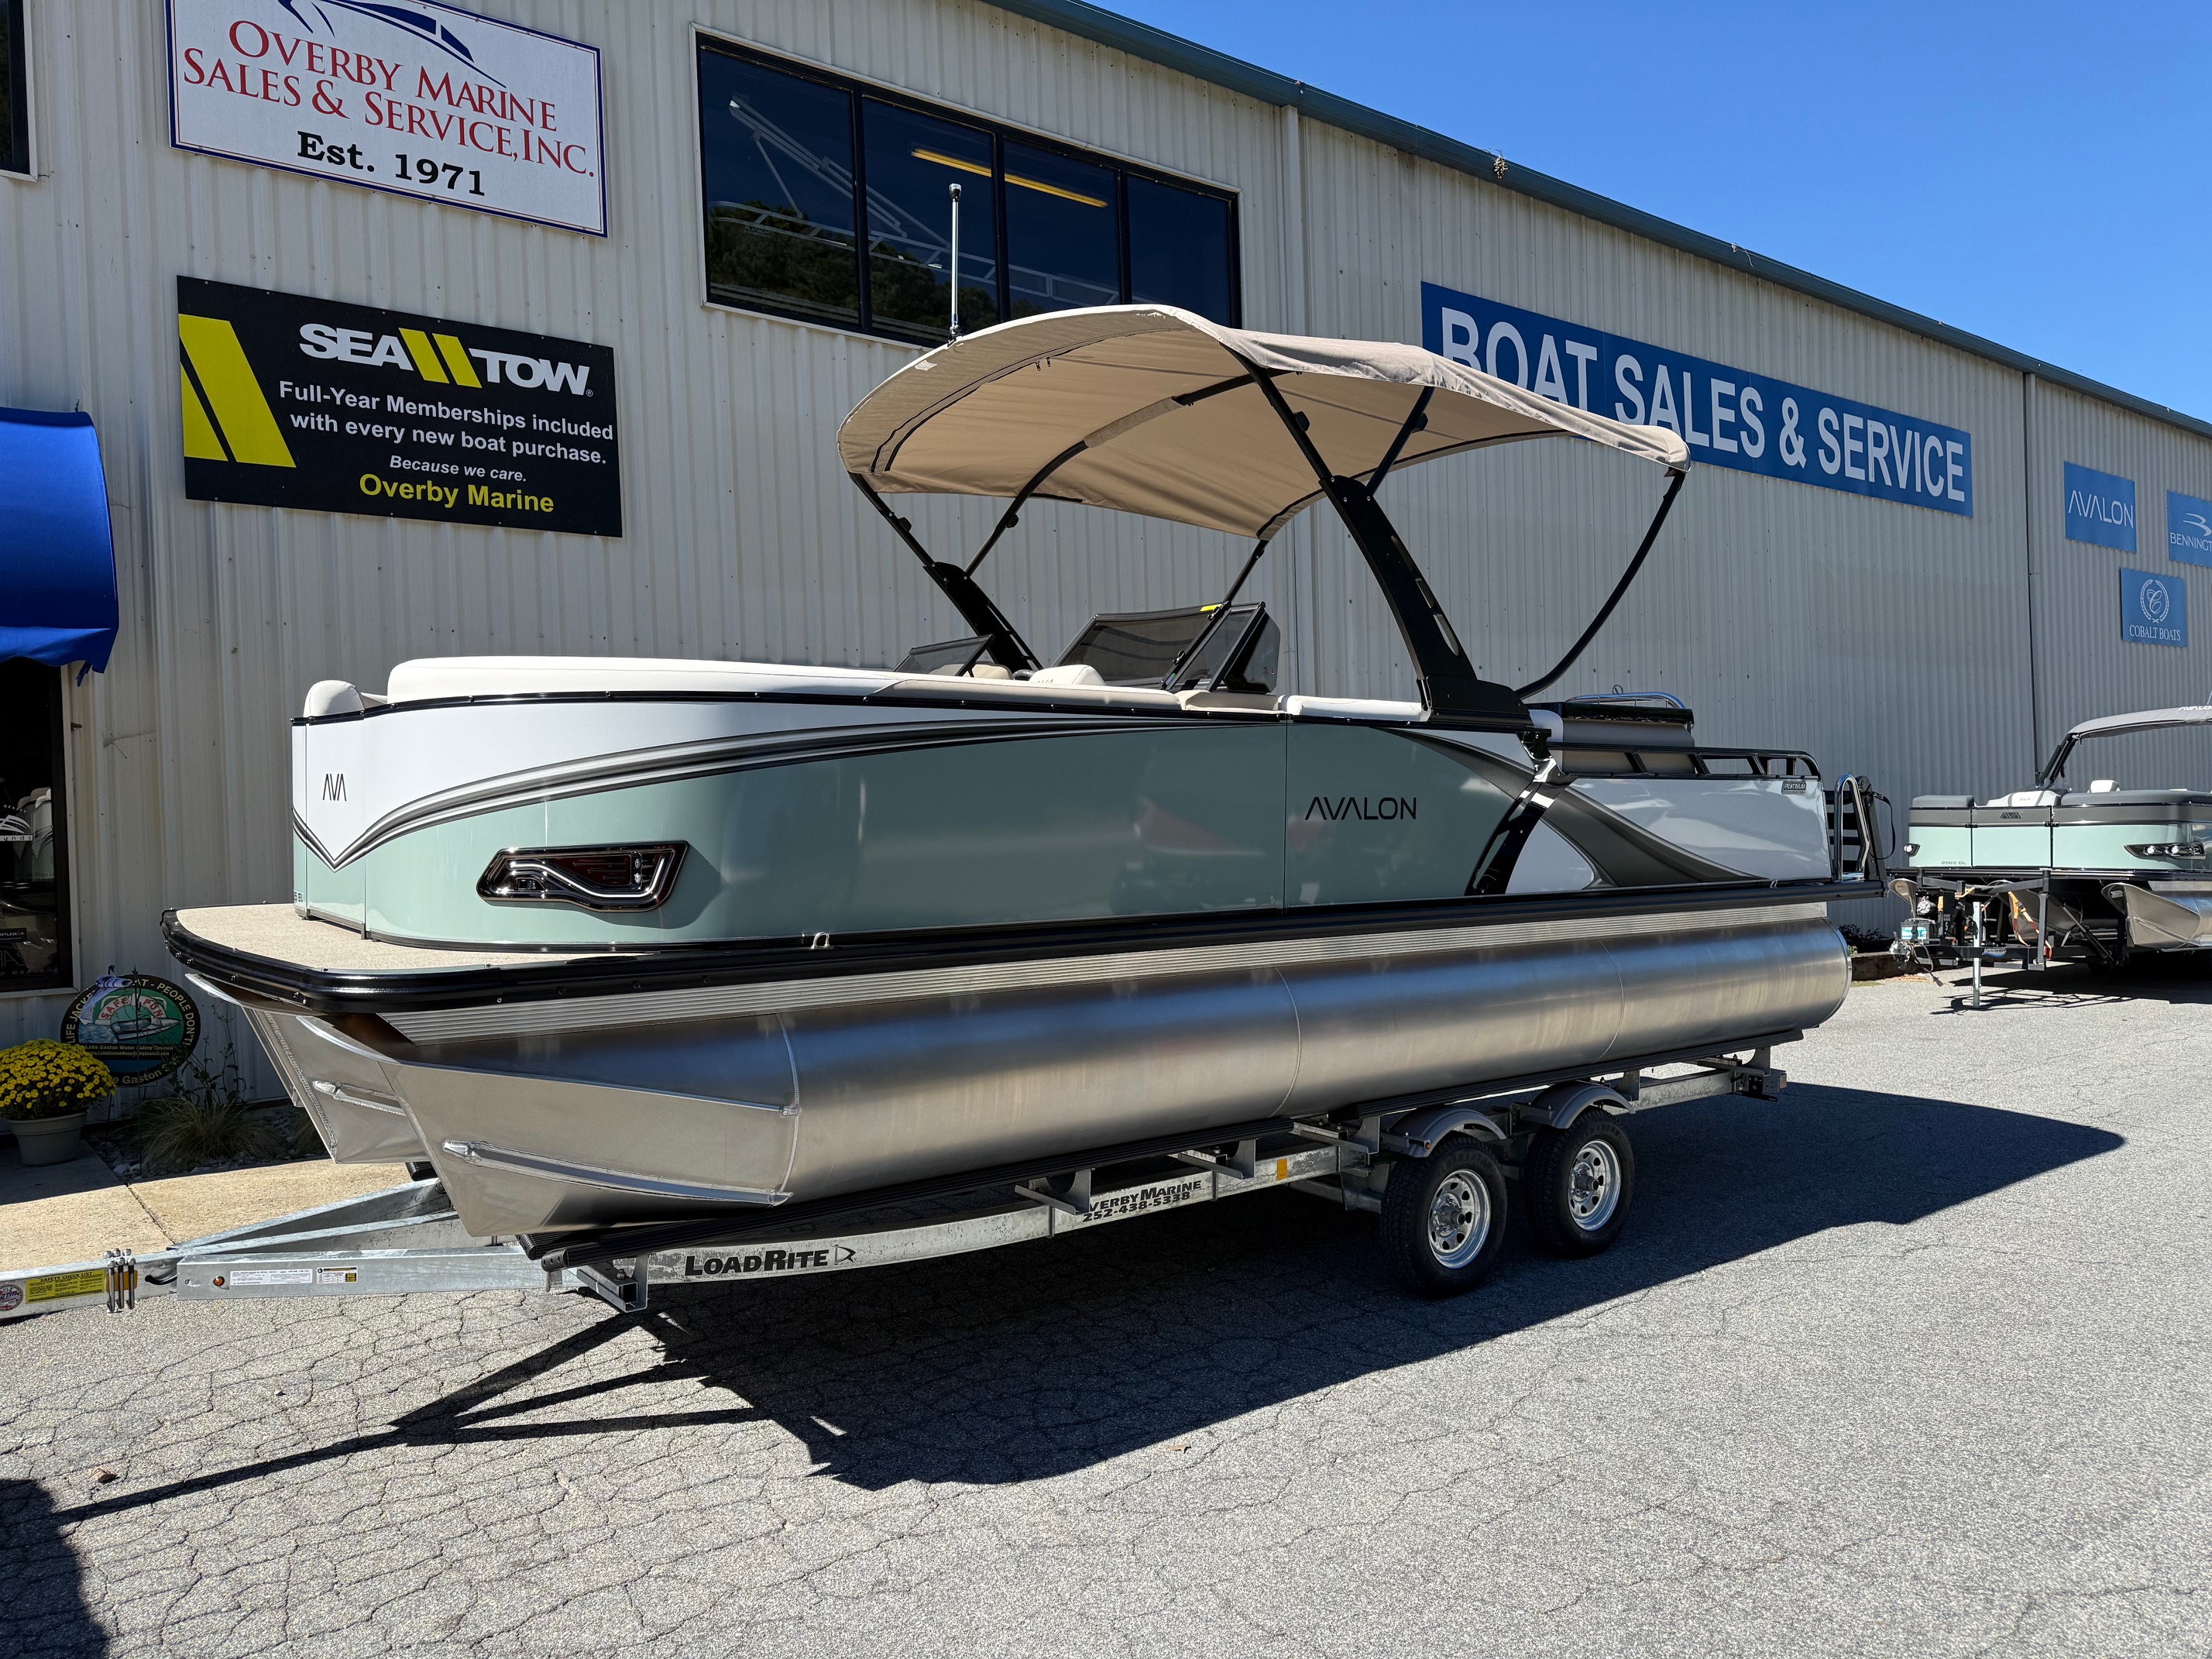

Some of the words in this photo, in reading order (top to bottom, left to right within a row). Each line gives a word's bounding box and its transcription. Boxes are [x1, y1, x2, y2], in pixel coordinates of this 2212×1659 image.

[184, 47, 301, 107] SALES
[311, 79, 351, 119] &
[229, 20, 403, 91] OVERBY
[414, 65, 557, 132] MARINE
[297, 130, 375, 173] Est.
[395, 153, 485, 196] 1971
[299, 323, 414, 371] SEA
[279, 380, 380, 410] Full-Year
[386, 394, 526, 430] Memberships
[532, 414, 613, 441] included
[1441, 306, 1598, 413] BOAT
[1614, 353, 1765, 459] SALES
[1781, 397, 1807, 469] &
[1818, 405, 1966, 503] SERVICE
[290, 412, 338, 432] with
[345, 421, 405, 444] every
[412, 429, 455, 446] new
[461, 431, 507, 452] boat
[512, 441, 606, 464] purchase.
[390, 455, 459, 475] Because
[464, 465, 486, 477] we
[489, 469, 527, 482] care.
[359, 473, 459, 508] Overby
[468, 484, 555, 513] Marine
[2068, 489, 2134, 528] AVALON
[2169, 531, 2212, 552] BENNINGT
[2129, 624, 2158, 640] COBALT
[2159, 627, 2181, 641] BOATS
[1305, 796, 1417, 820] AVALON
[66, 1023, 76, 1043] LIFE
[156, 982, 191, 1012] PEOPLE
[101, 998, 129, 1018] SAFE
[143, 998, 163, 1018] FUN
[122, 1070, 163, 1084] Gaston
[1083, 1191, 1190, 1222] 252-438-5338
[1090, 1193, 1139, 1212] VERBY
[1140, 1180, 1202, 1200] MARINE
